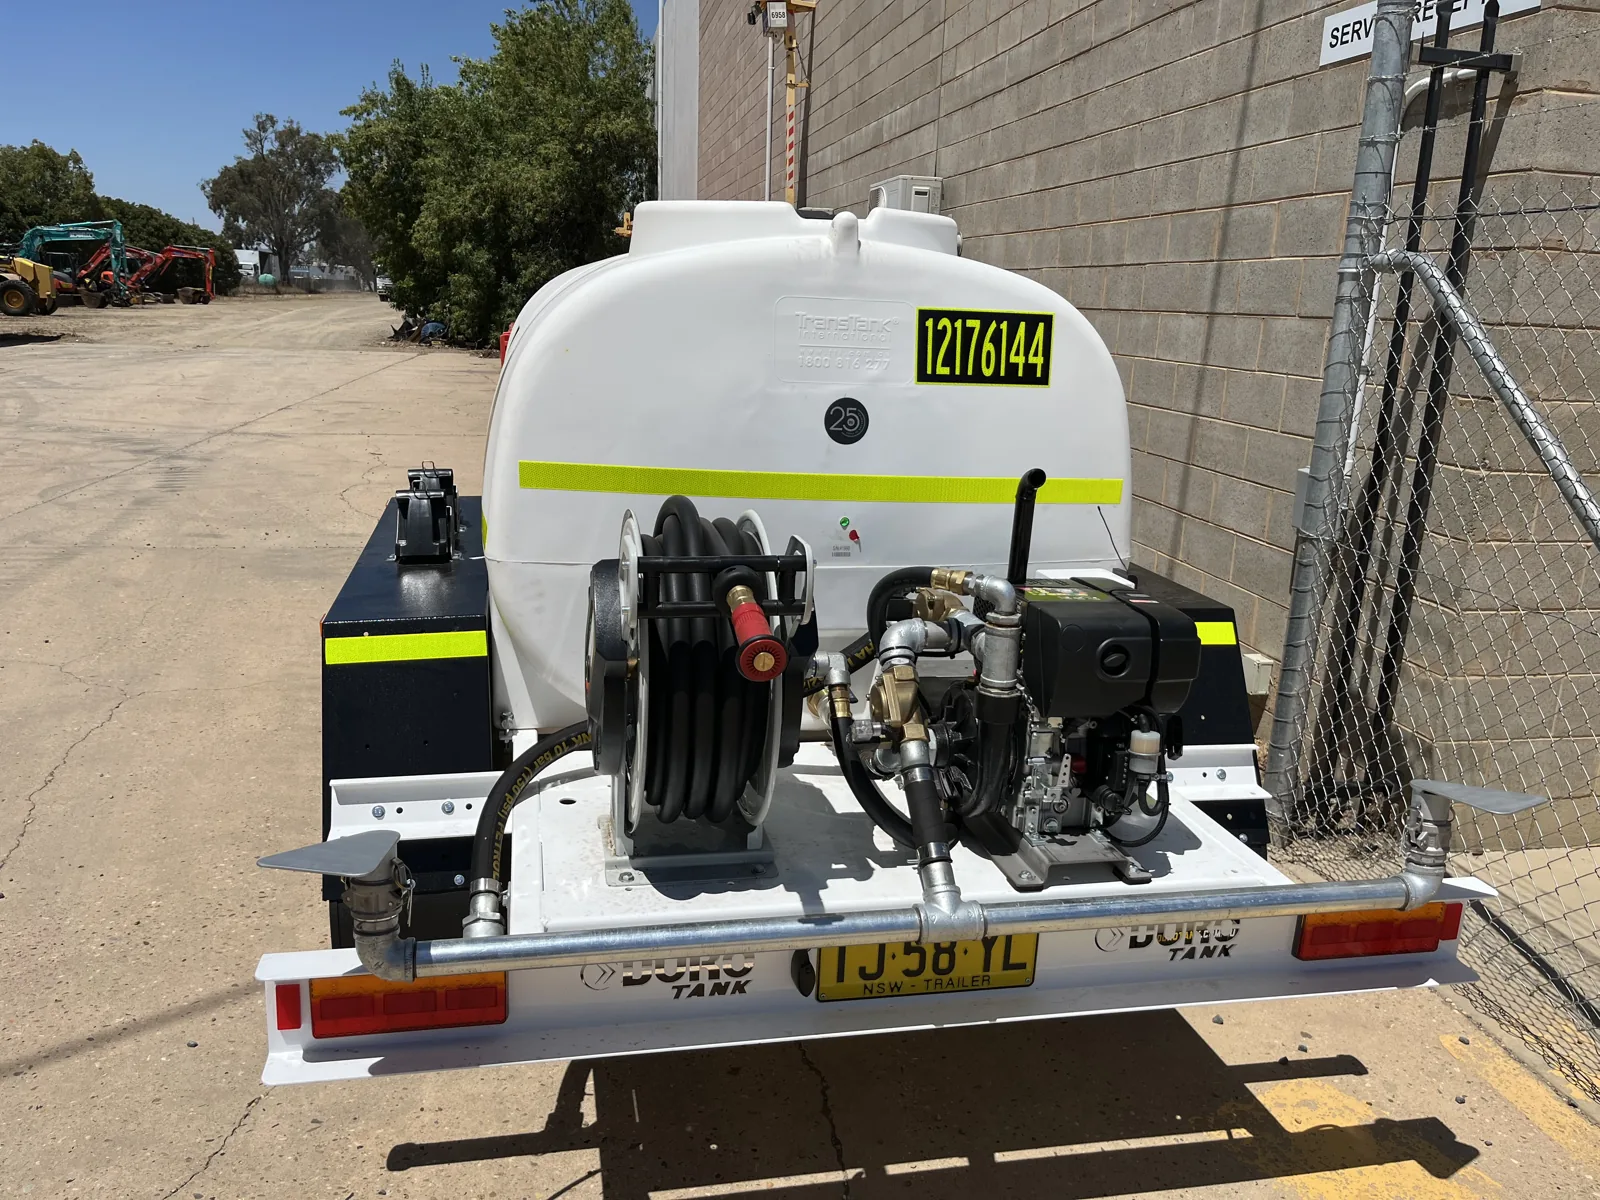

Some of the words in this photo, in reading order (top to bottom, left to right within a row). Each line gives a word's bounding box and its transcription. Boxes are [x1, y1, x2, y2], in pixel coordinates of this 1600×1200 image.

[771, 11, 786, 19] 6958
[1329, 16, 1375, 48] SERV
[925, 317, 1045, 378] 12176144
[798, 356, 831, 368] 1800
[865, 358, 890, 370] 277
[829, 406, 860, 432] 25
[555, 743, 570, 753] 10
[534, 752, 553, 769] bar
[512, 766, 533, 795] (150
[498, 793, 515, 819] psi)
[1169, 944, 1238, 961] TANK
[671, 979, 752, 1000] TANK
[864, 982, 903, 996] NSW
[926, 975, 991, 991] TRAILER
